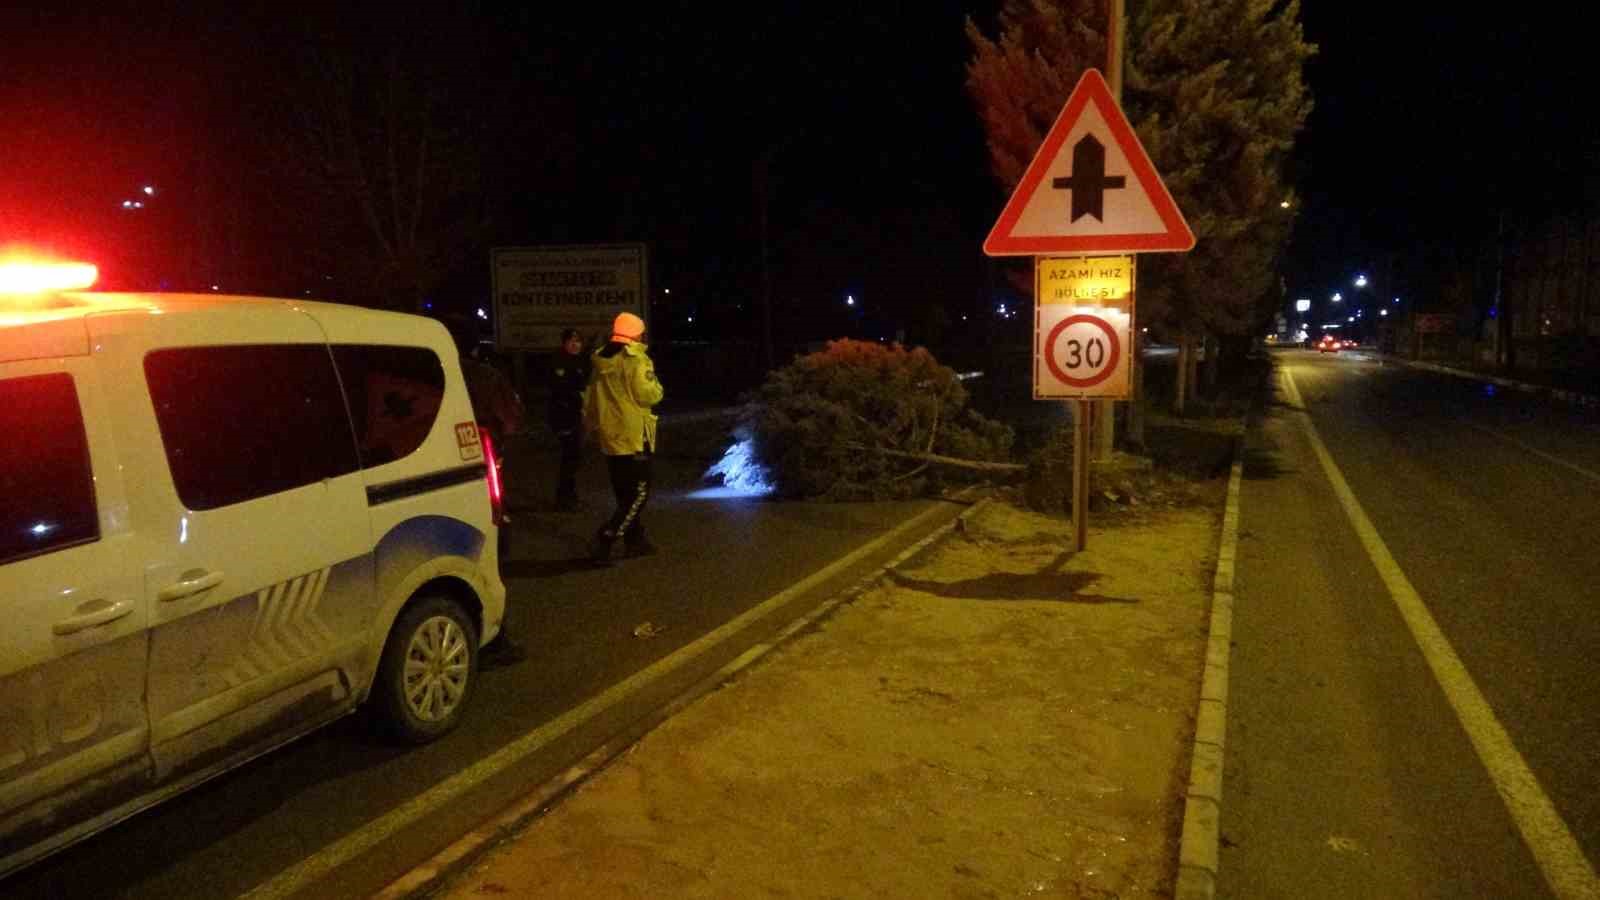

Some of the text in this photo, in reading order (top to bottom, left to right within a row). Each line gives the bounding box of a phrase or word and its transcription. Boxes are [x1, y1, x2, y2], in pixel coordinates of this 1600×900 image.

[1100, 268, 1121, 278] HIZ
[1065, 337, 1104, 369] 30
[458, 425, 480, 444] 112
